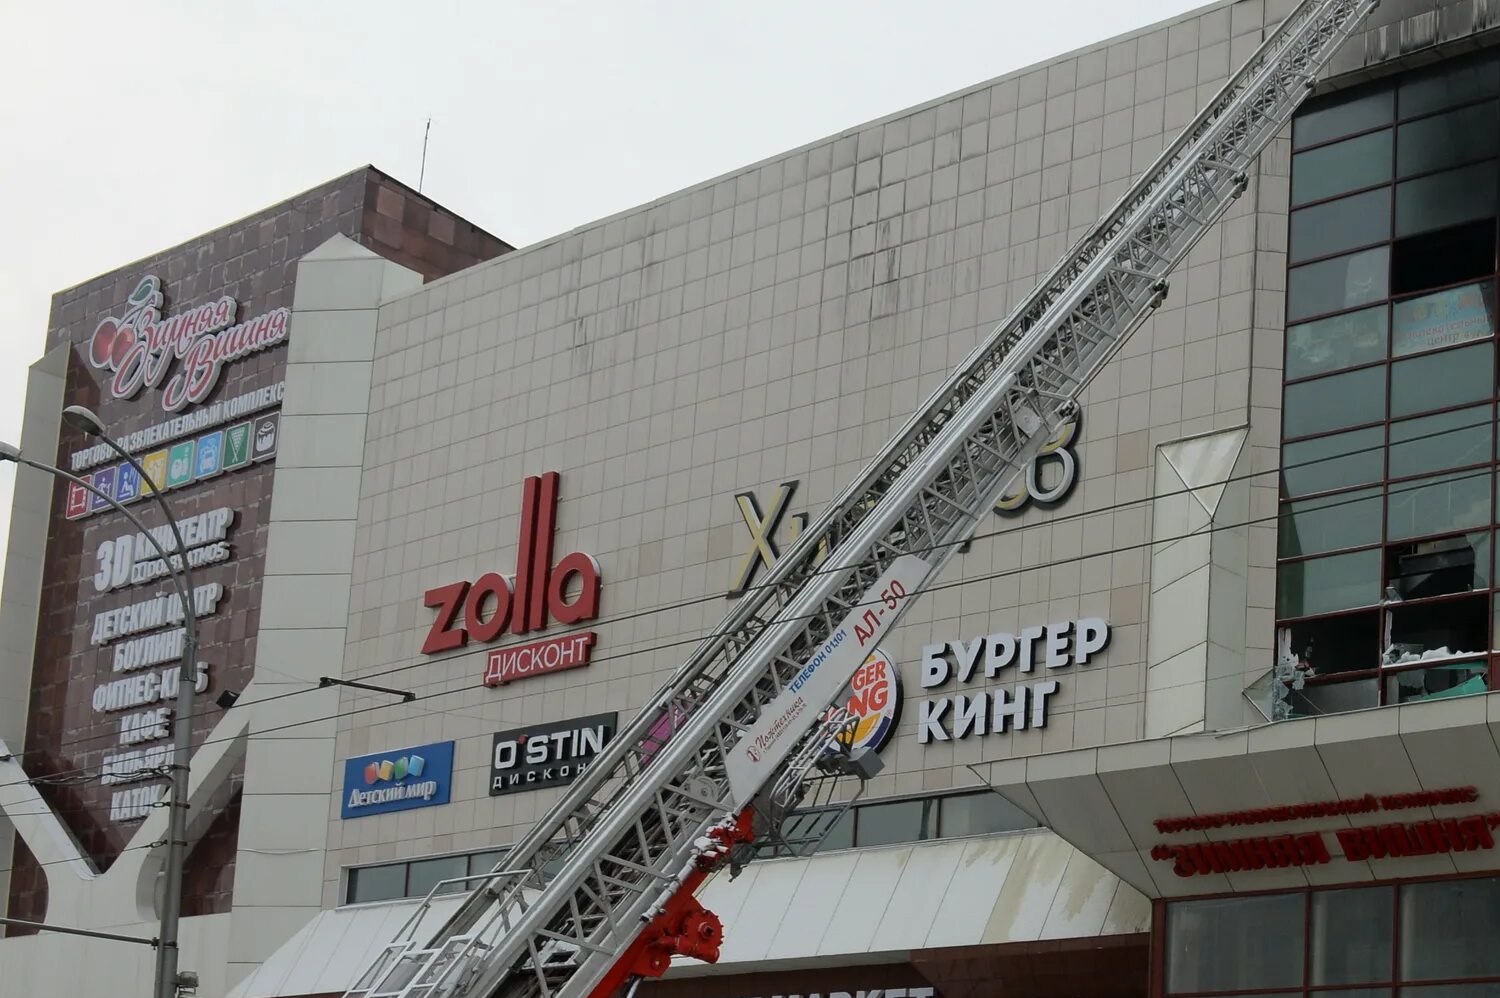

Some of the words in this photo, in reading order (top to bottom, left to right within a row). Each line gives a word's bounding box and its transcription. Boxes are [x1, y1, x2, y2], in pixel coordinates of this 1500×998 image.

[223, 380, 285, 422] КОМПЛЕКС
[94, 534, 135, 592] 3D
[421, 471, 601, 655] zolla
[91, 591, 167, 645] ДЕТСКИЙ
[486, 637, 588, 682] ДИСКОНТ
[789, 653, 826, 694] ТЕЛЕФОН
[921, 617, 1112, 689] БУРГЕР
[92, 661, 209, 712] ФИТНЕС-КЛБ
[119, 707, 171, 744] КАФЕ
[918, 681, 1060, 745] КИНГ
[348, 781, 405, 808] Детский
[405, 780, 437, 803] мир
[493, 762, 588, 790] ДИСКОН
[110, 784, 166, 821] КАТОК
